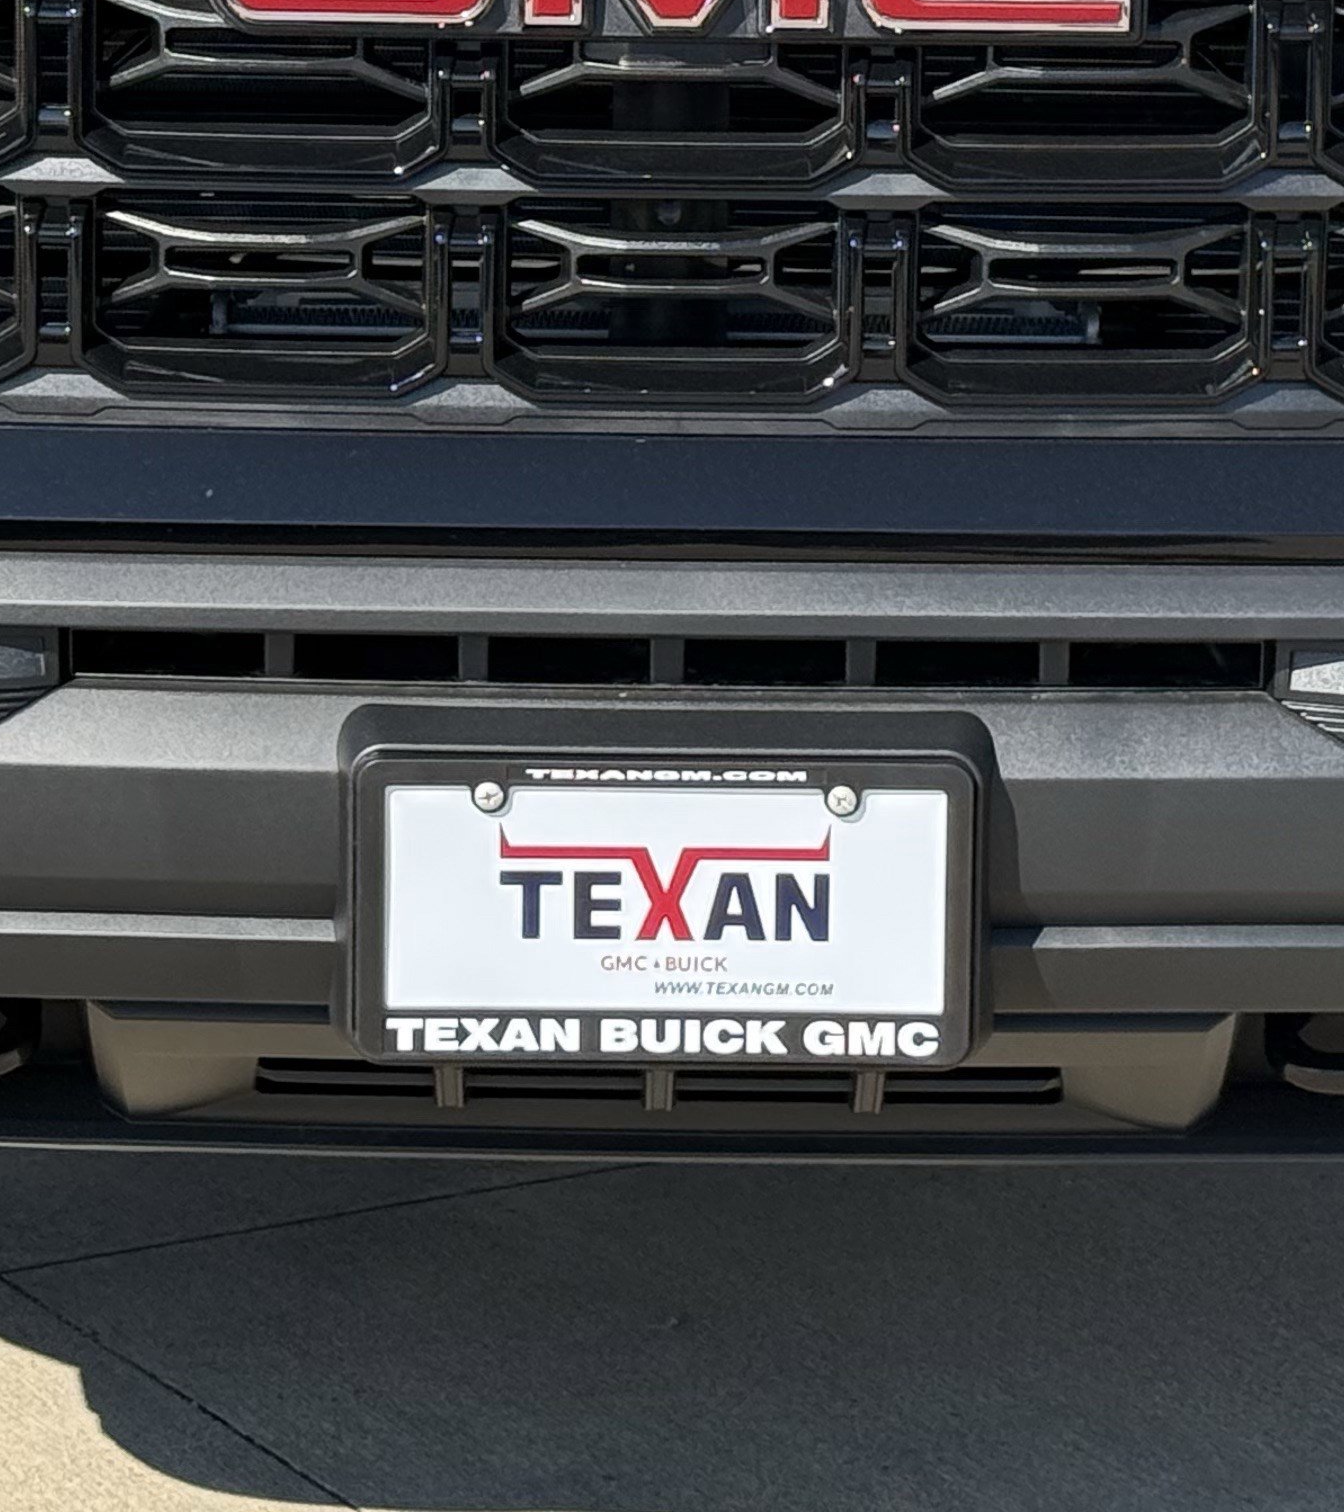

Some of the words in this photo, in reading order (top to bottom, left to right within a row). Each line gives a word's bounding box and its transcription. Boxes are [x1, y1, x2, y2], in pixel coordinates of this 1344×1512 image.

[524, 768, 807, 782] TEXANGM.COM
[499, 844, 830, 942] TEXAN
[600, 955, 648, 972] GMC
[664, 955, 729, 973] BUICK
[654, 980, 835, 997] WWW.TEXANGM.COM
[385, 1017, 581, 1053] TEXAN
[599, 1018, 790, 1055] BUICK
[802, 1020, 941, 1058] GMC
